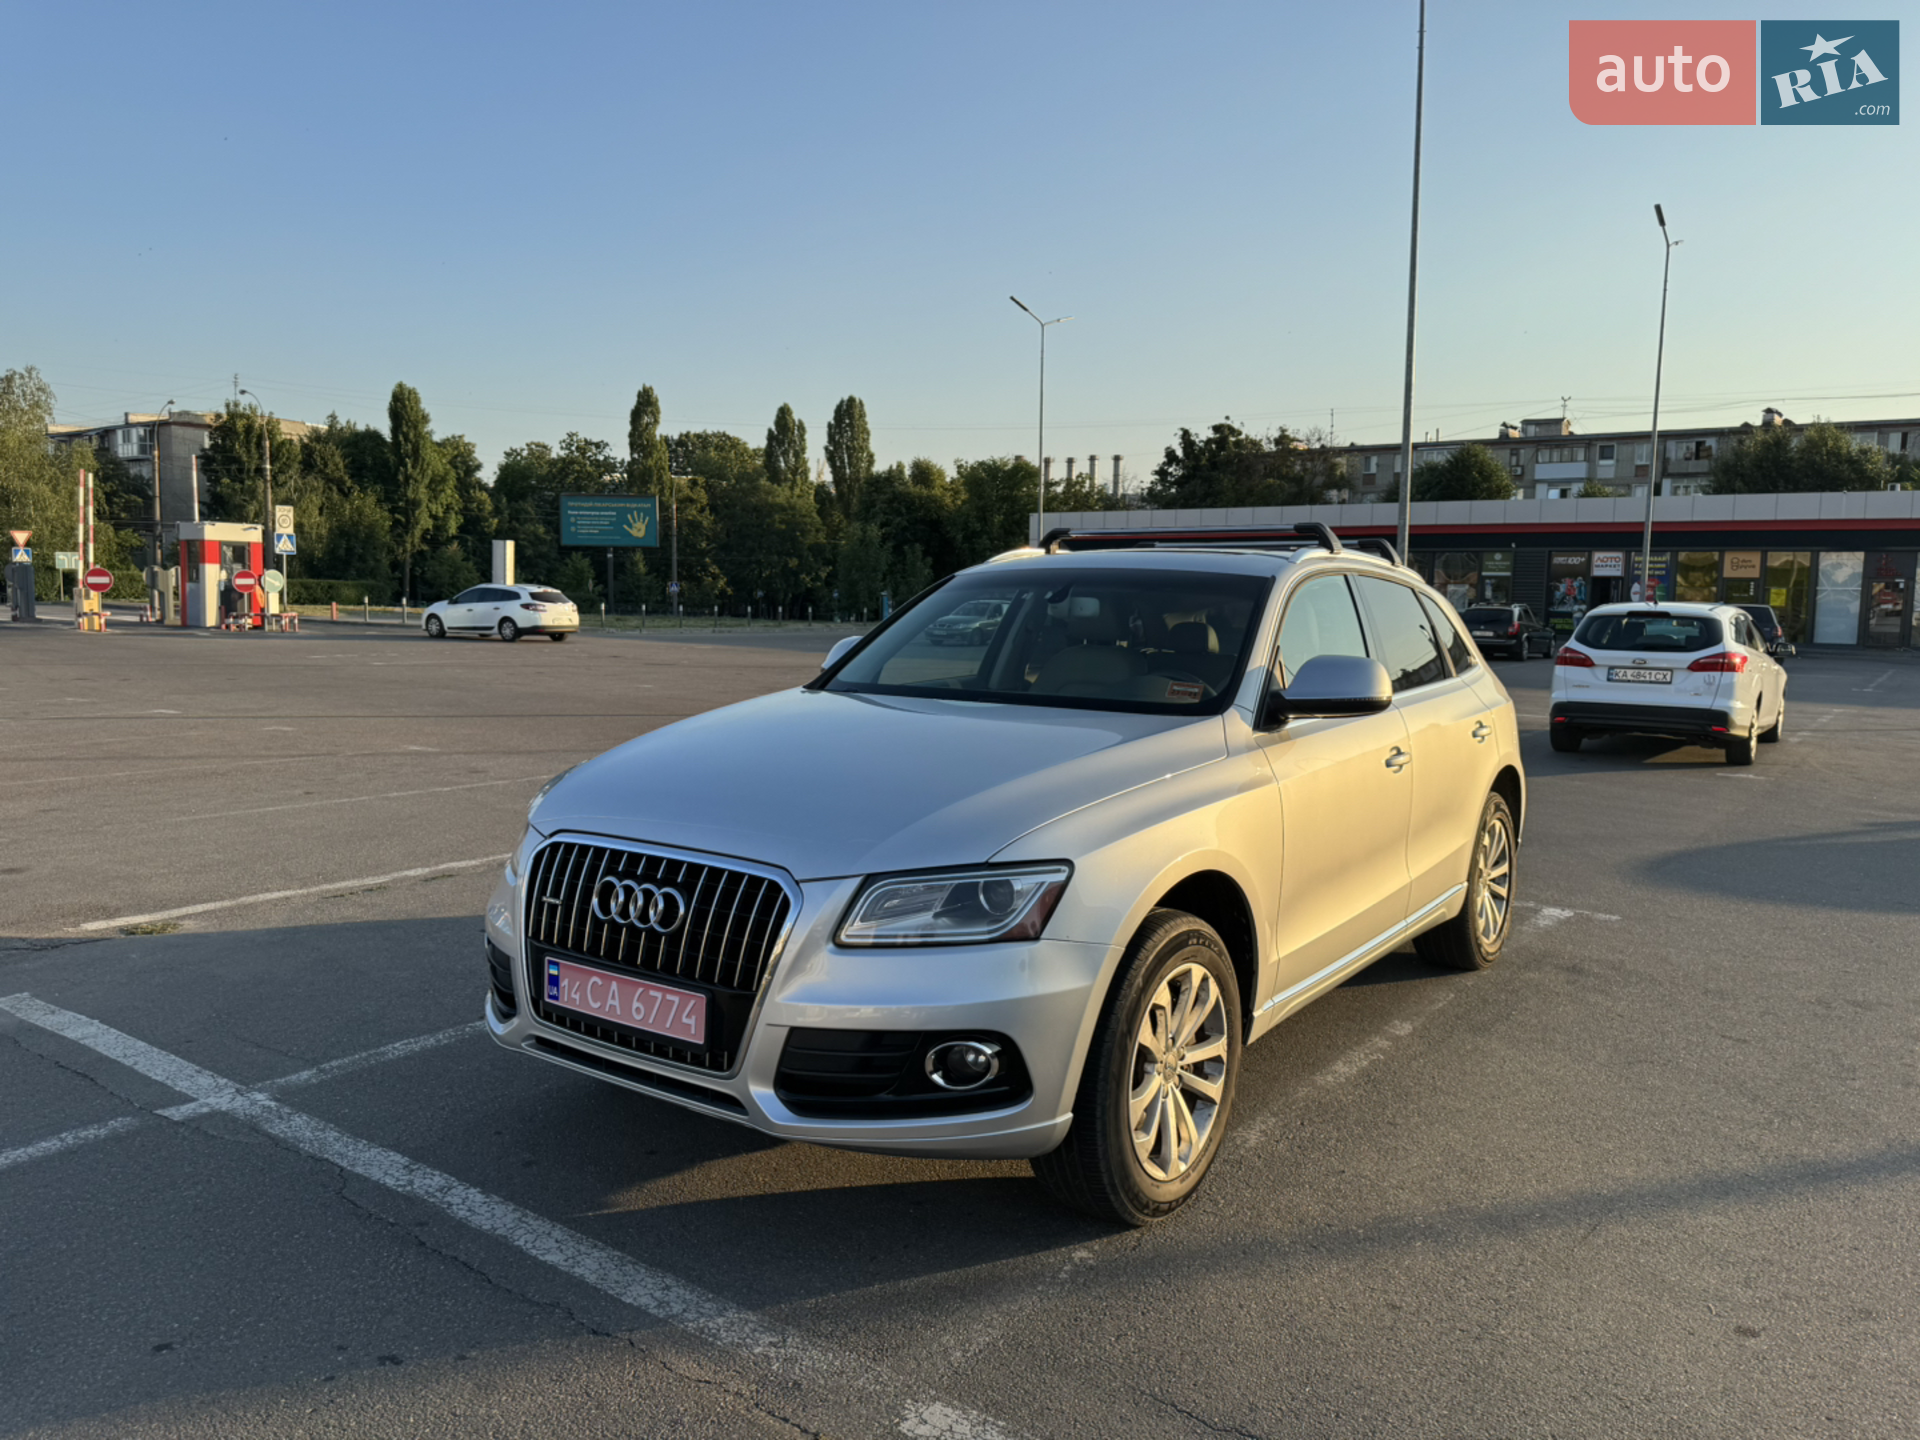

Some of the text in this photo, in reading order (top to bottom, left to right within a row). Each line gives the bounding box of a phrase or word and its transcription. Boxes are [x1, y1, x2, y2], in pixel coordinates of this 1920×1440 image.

[1595, 555, 1622, 564] ЛОТО
[1613, 669, 1670, 681] KA 4841 CX
[548, 984, 559, 997] UA
[561, 975, 697, 1036] 14 CA 6774
